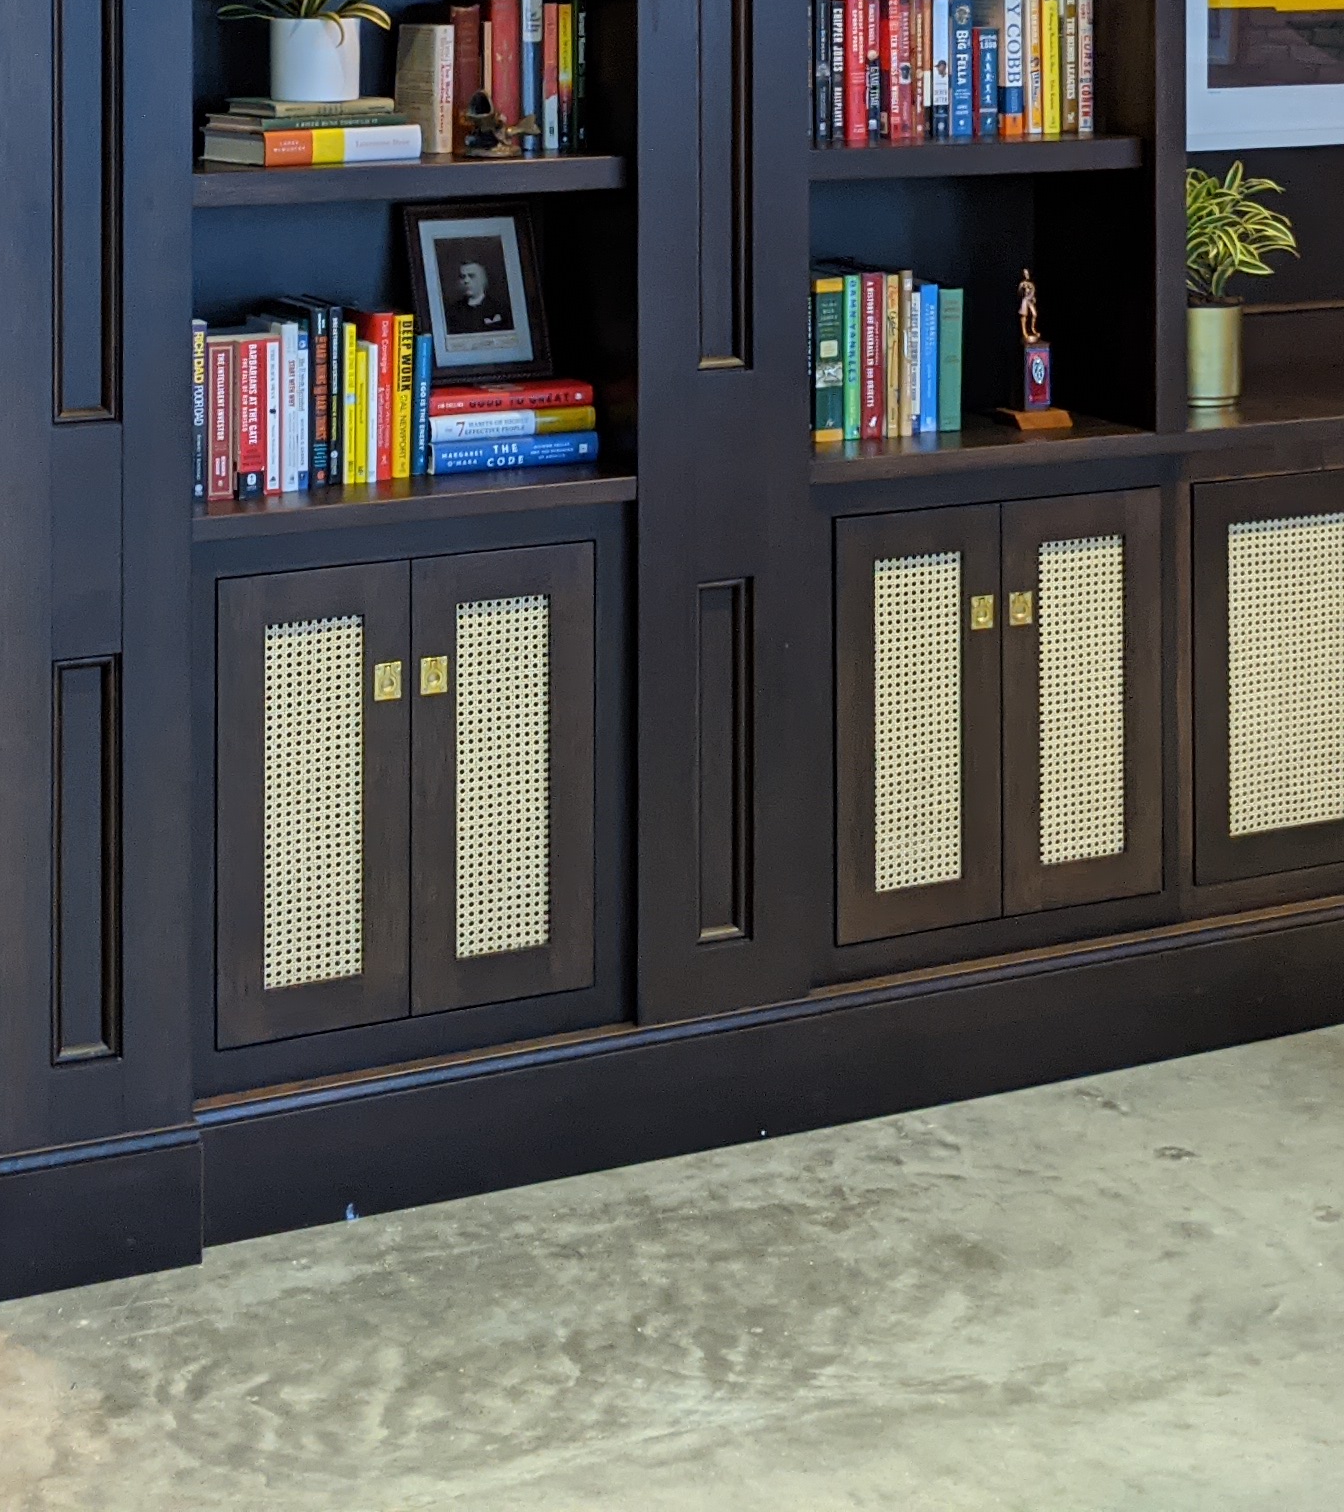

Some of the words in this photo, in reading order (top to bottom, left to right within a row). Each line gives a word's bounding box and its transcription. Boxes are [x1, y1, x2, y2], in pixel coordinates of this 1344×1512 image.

[833, 8, 844, 42] CHIPPER
[1066, 17, 1075, 34] THE
[956, 29, 968, 50] BIG
[833, 45, 843, 72] JONES
[1006, 22, 1021, 84] COBB
[1083, 34, 1091, 76] CURSE
[956, 53, 968, 85] FELLA
[1066, 64, 1075, 99] LEAGUES
[833, 87, 843, 127] BALLPLAYER
[869, 89, 880, 108] TIME
[891, 85, 900, 113] WRIGLEY
[1081, 84, 1092, 117] COHEN
[848, 279, 857, 319] DAMN
[866, 287, 875, 314] HISTORY
[866, 315, 875, 324] OF
[194, 331, 205, 357] RICH
[401, 320, 413, 350] DEEP
[866, 326, 875, 357] BASEBALL
[216, 353, 225, 364] THE
[380, 338, 390, 374] Carnegie
[848, 320, 858, 382] YANKEES
[194, 358, 205, 384] DAD
[248, 344, 258, 394] BARBARIANS
[288, 359, 296, 377] START
[401, 353, 413, 392] WORK
[194, 384, 204, 407] POOR
[216, 365, 225, 407] INTELLIGENT
[288, 378, 296, 394] WITH
[419, 382, 427, 397] EGO
[866, 380, 875, 408] OBJECTS
[248, 396, 258, 406] AT
[288, 395, 296, 408] WHY
[399, 394, 408, 413] CAL
[419, 397, 427, 407] IS
[469, 399, 503, 408] GOOD
[509, 398, 525, 406] TO
[528, 393, 570, 405] GREAT
[194, 406, 204, 427] DAD
[216, 409, 225, 441] INVESTOR
[248, 407, 258, 423] THE
[419, 407, 427, 423] THE
[248, 425, 258, 445] GATE
[399, 415, 408, 459] NEWPORT
[456, 421, 465, 437] 7
[464, 426, 500, 436] EFFECTIVE
[501, 425, 526, 433] PEOPLE
[441, 450, 483, 459] MARGARET
[493, 443, 518, 454] THE
[447, 458, 478, 467] O'MARA
[486, 455, 524, 467] CODE
